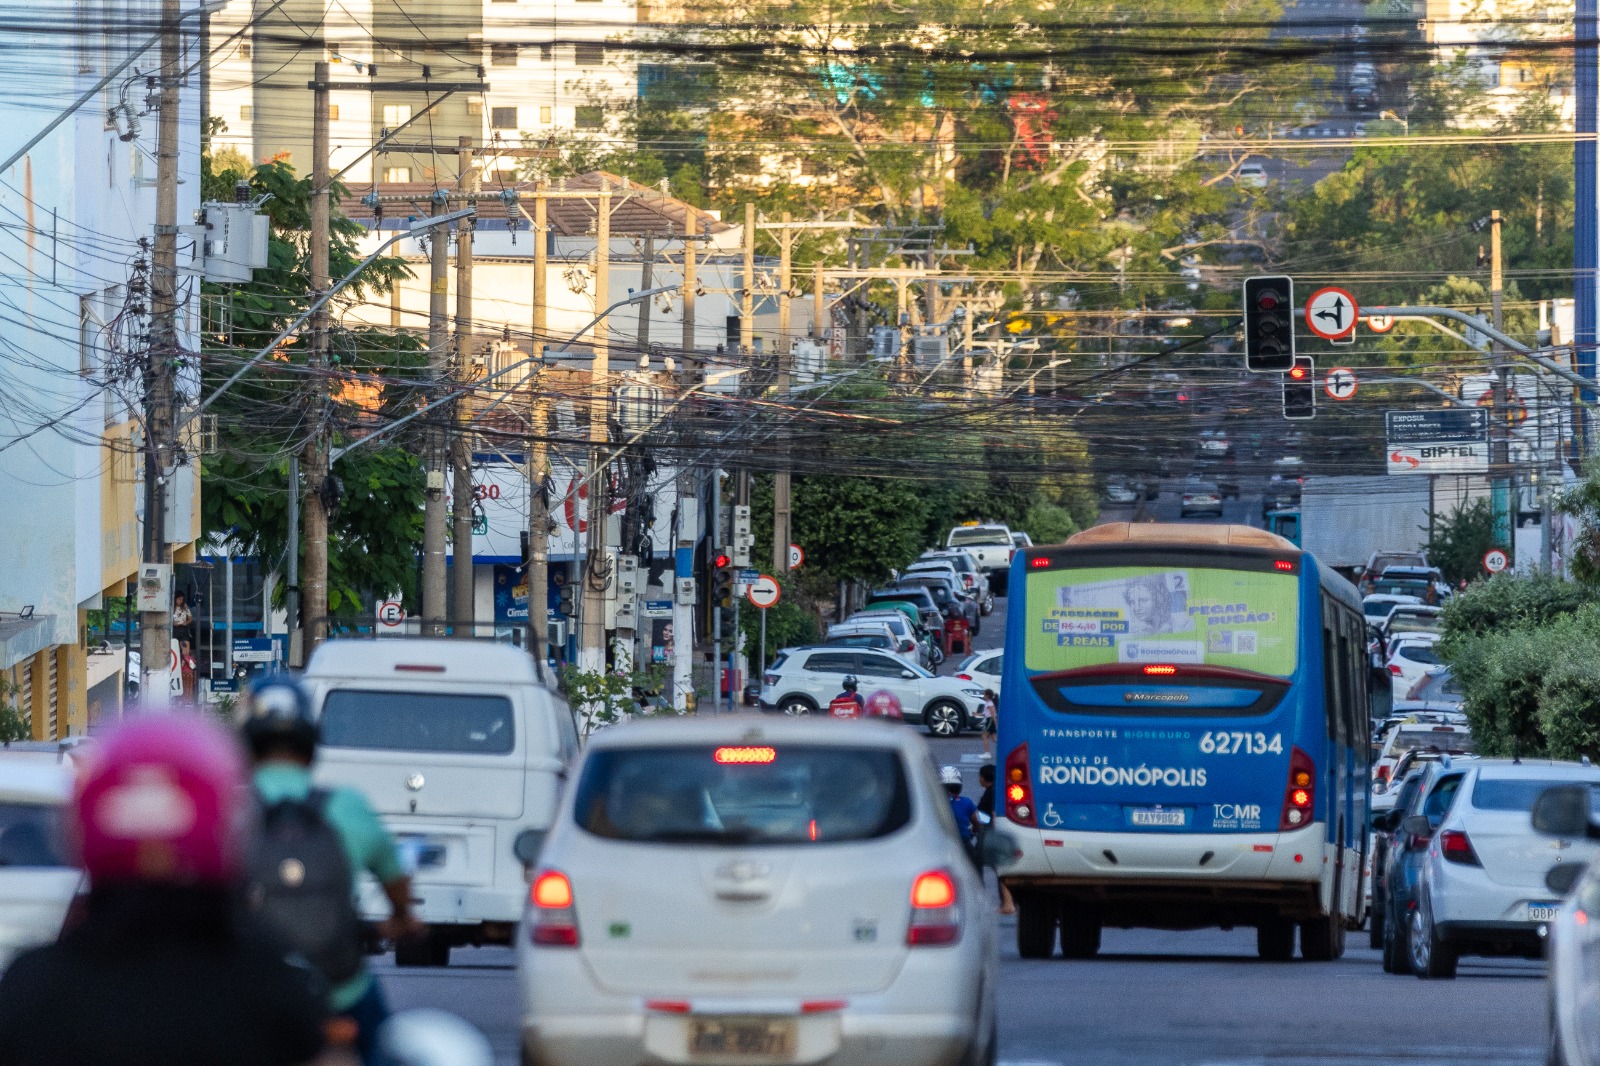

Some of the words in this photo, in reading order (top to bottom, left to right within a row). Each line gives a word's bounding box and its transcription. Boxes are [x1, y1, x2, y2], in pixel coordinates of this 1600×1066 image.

[1420, 446, 1478, 458] BIPTEL
[1489, 557, 1503, 566] 40
[387, 608, 396, 621] E
[1044, 622, 1059, 630] DE
[1102, 623, 1125, 631] POR
[1062, 636, 1070, 646] 2
[1073, 636, 1110, 646] REAIS
[1133, 693, 1189, 701] Marcopolo
[1042, 729, 1118, 738] TRANSPORTE
[1200, 731, 1283, 755] 627134
[1041, 756, 1087, 764] CIDADE
[1094, 756, 1108, 764] DE
[1040, 763, 1207, 787] RONDONÓPOLIS
[1213, 804, 1261, 819] TCMR
